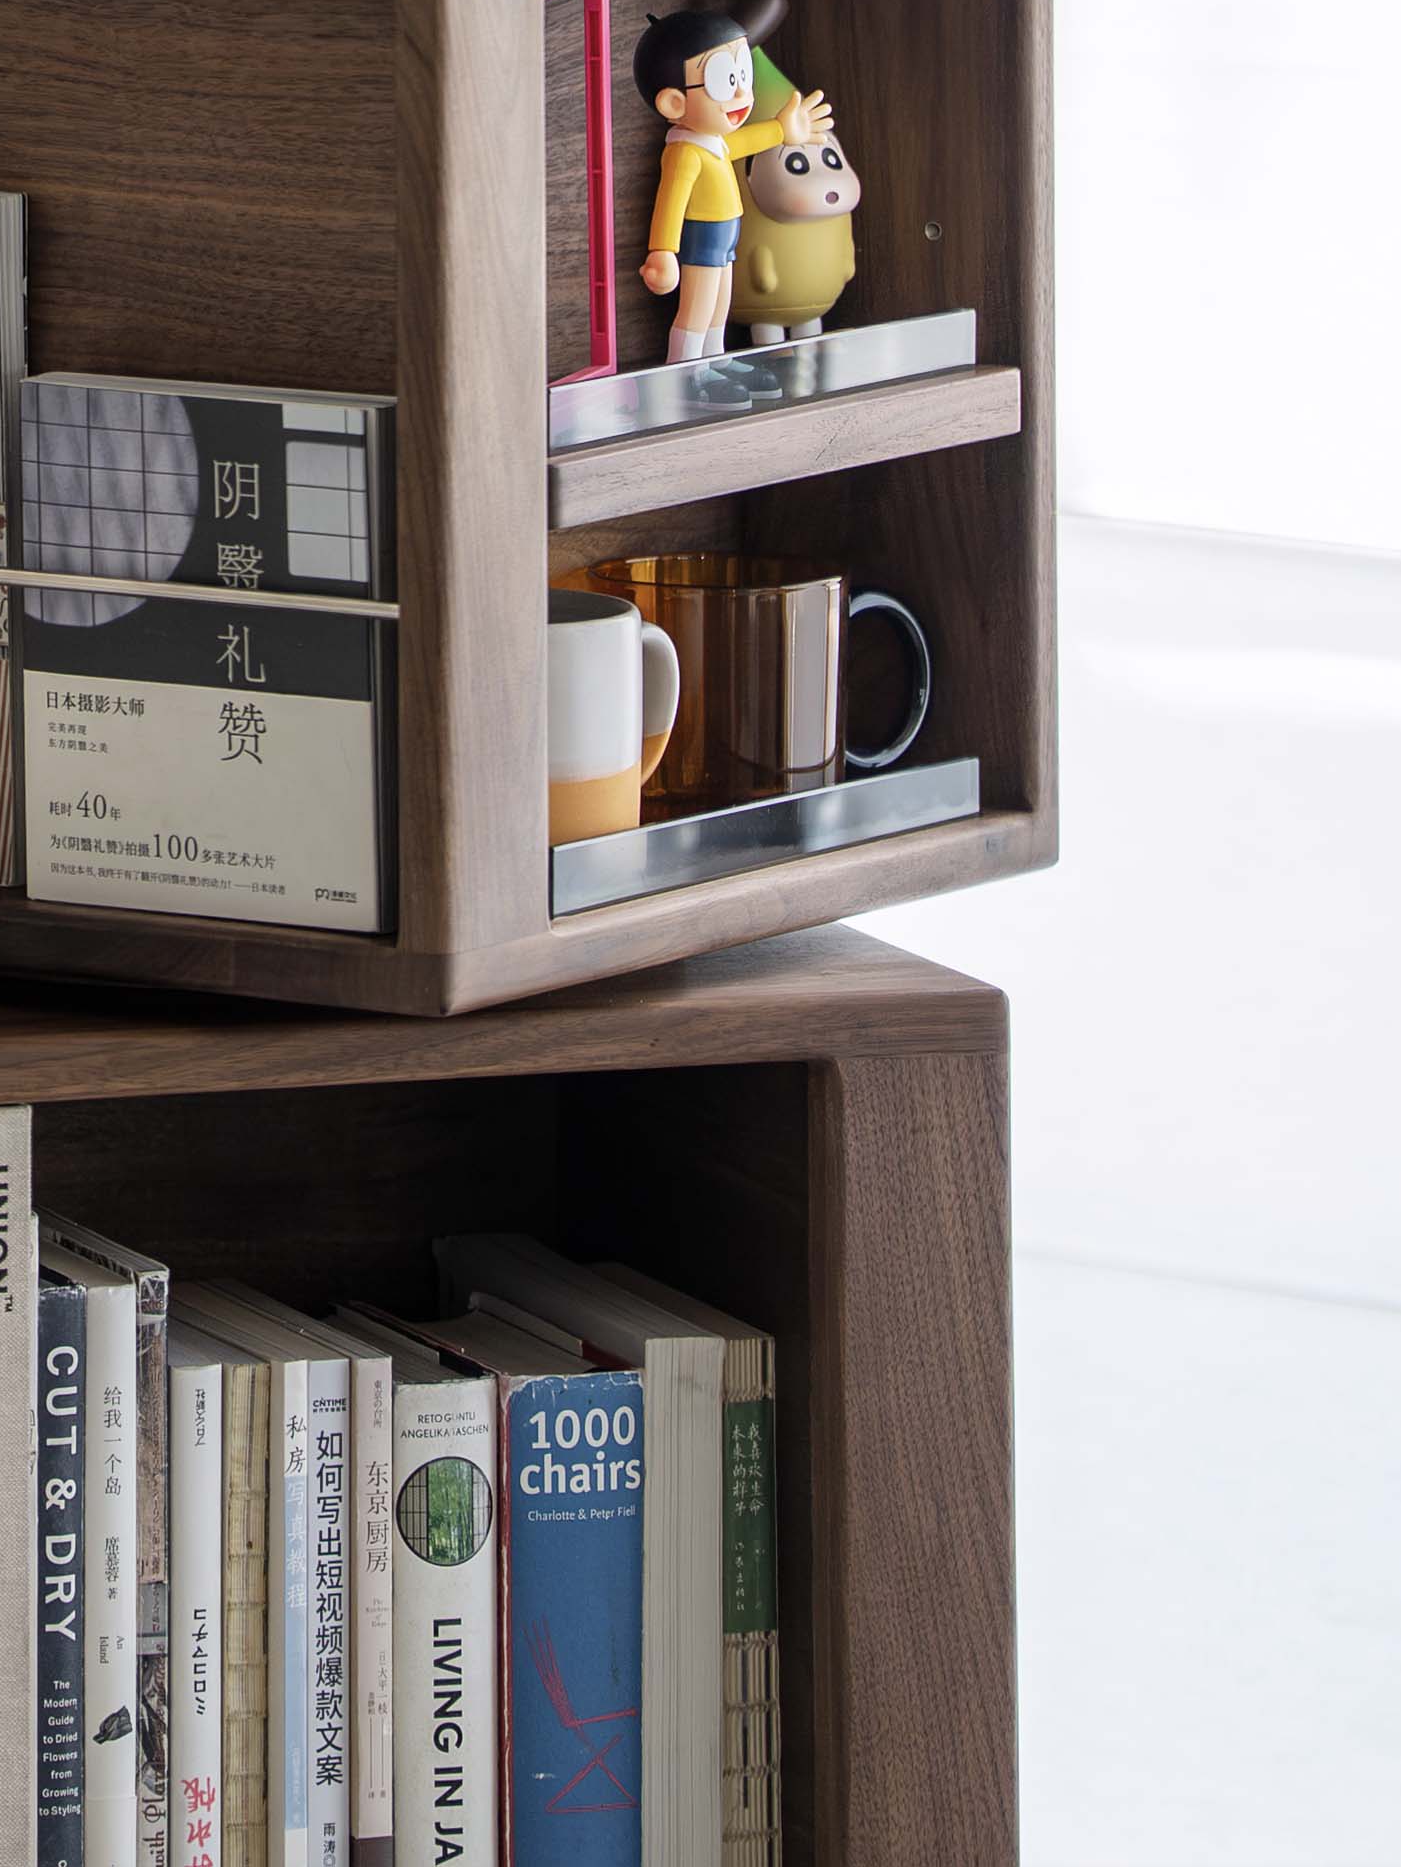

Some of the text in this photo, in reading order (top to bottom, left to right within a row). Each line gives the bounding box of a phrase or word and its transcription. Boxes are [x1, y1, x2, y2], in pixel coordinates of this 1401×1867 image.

[212, 459, 267, 765] 阴翳礼赞
[46, 690, 145, 718] 日本摄影大师
[417, 1413, 443, 1424] RETO
[528, 1405, 636, 1450] 1000
[103, 1385, 122, 1496] 给我一个岛
[400, 1428, 450, 1439] ANGELIKA
[519, 1450, 642, 1495] chairs
[45, 1345, 79, 1642] CUT & DRY
[365, 1460, 390, 1573] 东京厨房
[527, 1504, 636, 1522] Charlotte & Peter Fiell
[315, 1430, 344, 1786] 如何写出短视频爆款文案
[192, 1608, 209, 1715] ミロコマチコ
[53, 1680, 71, 1691] The
[433, 1617, 463, 1754] LIVING
[43, 1697, 78, 1709] Modern
[48, 1715, 75, 1727] Guide
[43, 1732, 78, 1745] to Dried
[42, 1750, 78, 1763] Flowers
[50, 1768, 73, 1780] from
[42, 1785, 79, 1799] Growing
[434, 1765, 464, 1808] IN
[39, 1802, 81, 1817] to Styling
